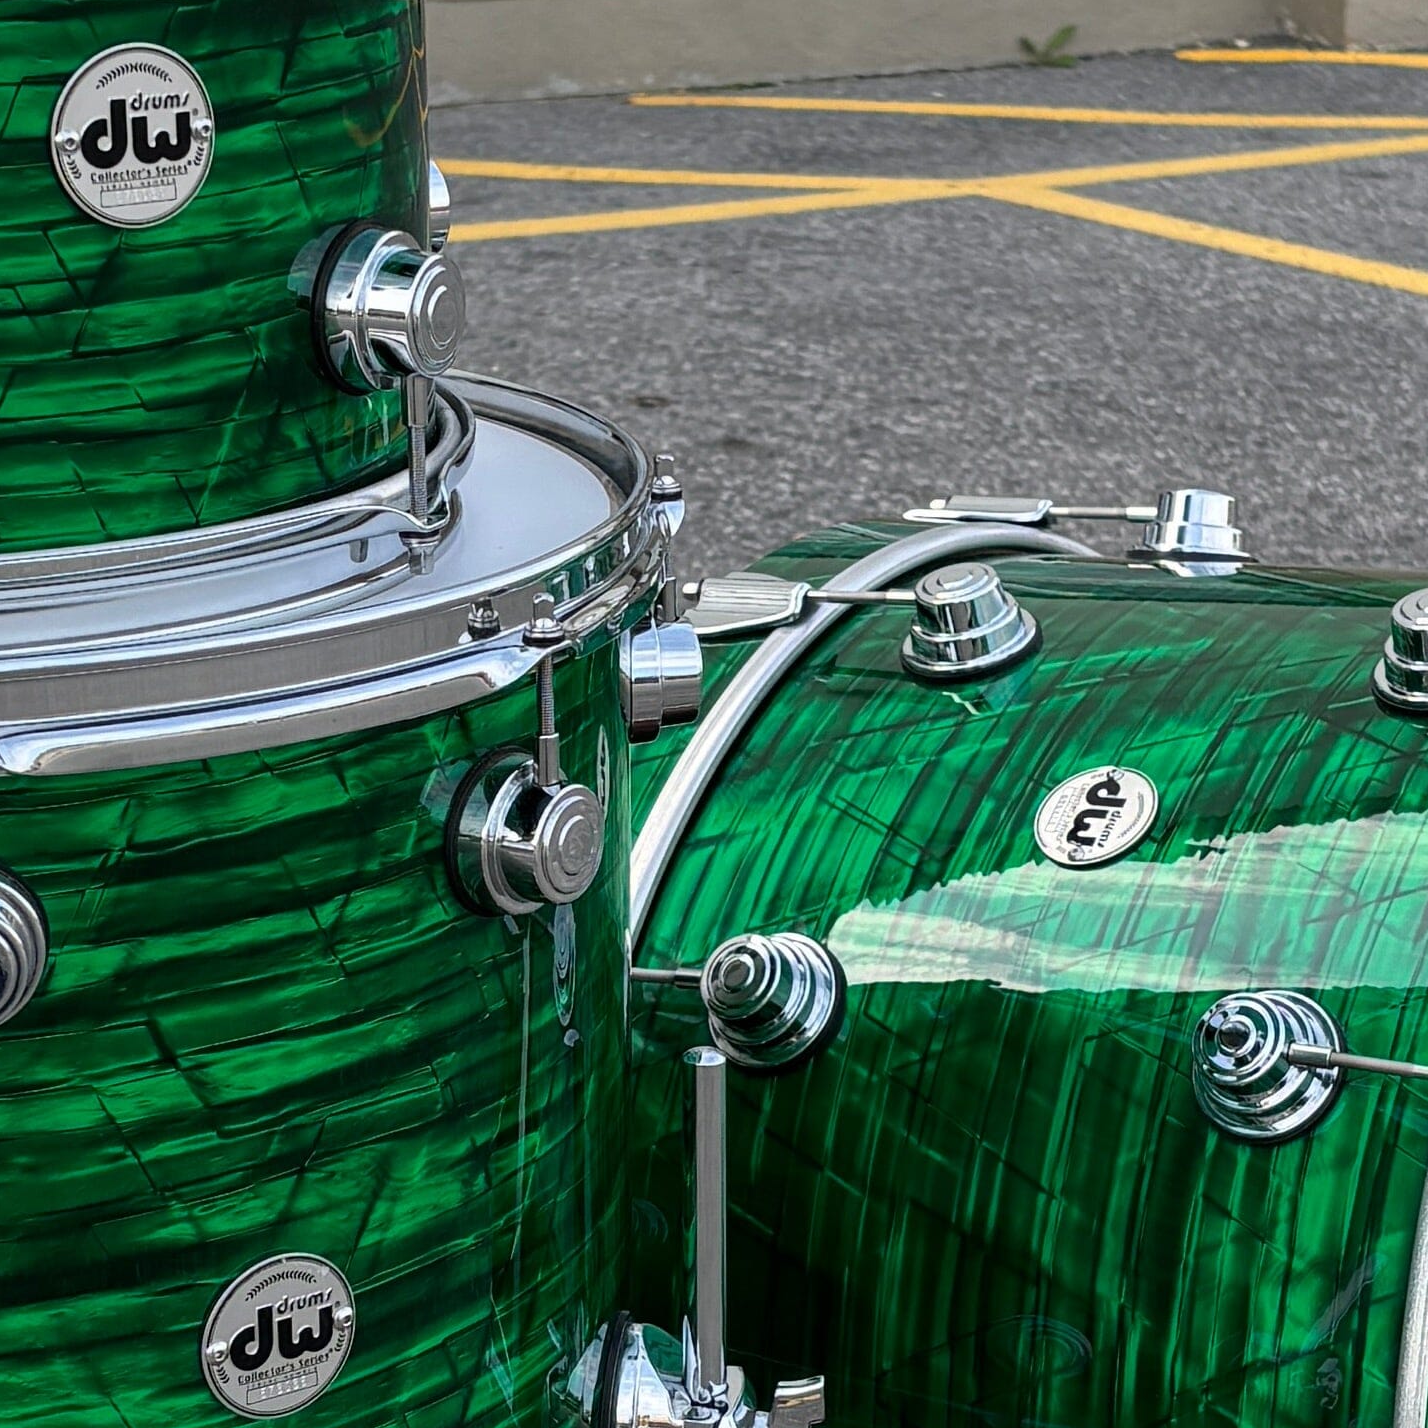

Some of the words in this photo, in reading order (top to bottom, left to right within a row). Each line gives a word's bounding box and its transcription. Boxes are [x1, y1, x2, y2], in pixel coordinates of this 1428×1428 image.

[130, 89, 190, 111] drums
[81, 99, 192, 169] dw
[90, 168, 151, 184] Collector's
[276, 1288, 333, 1315] drums
[229, 1303, 334, 1371] dw
[238, 1363, 295, 1386] Collector's
